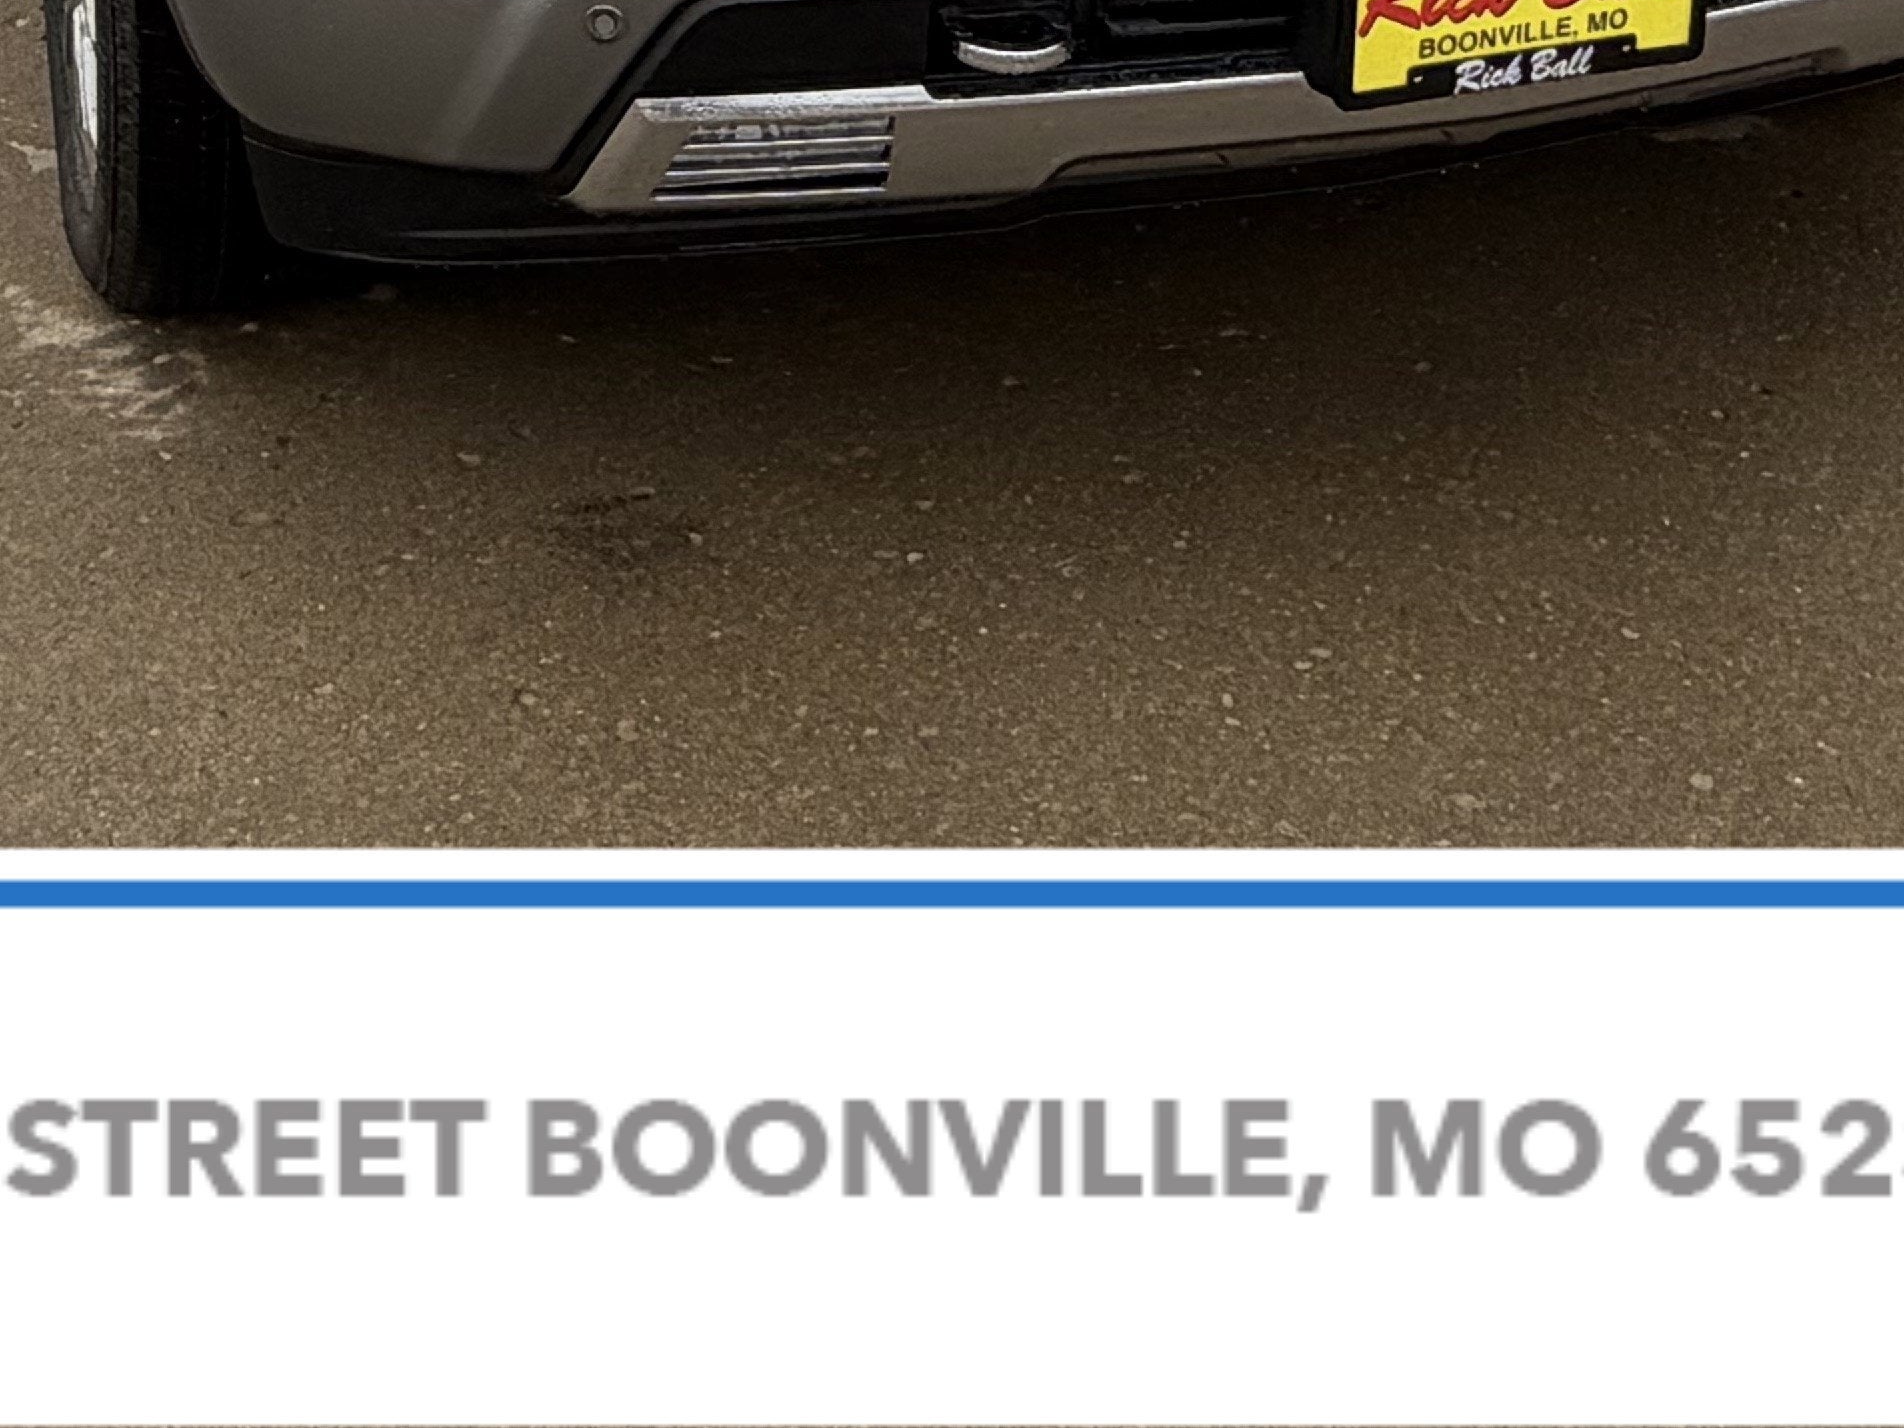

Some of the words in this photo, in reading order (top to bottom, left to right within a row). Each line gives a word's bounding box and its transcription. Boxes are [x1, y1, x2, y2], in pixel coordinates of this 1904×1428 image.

[1418, 15, 1578, 60] BOONVILLE,
[1586, 8, 1628, 33] MO
[1453, 53, 1524, 95] Rick
[1530, 44, 1594, 82] Ball
